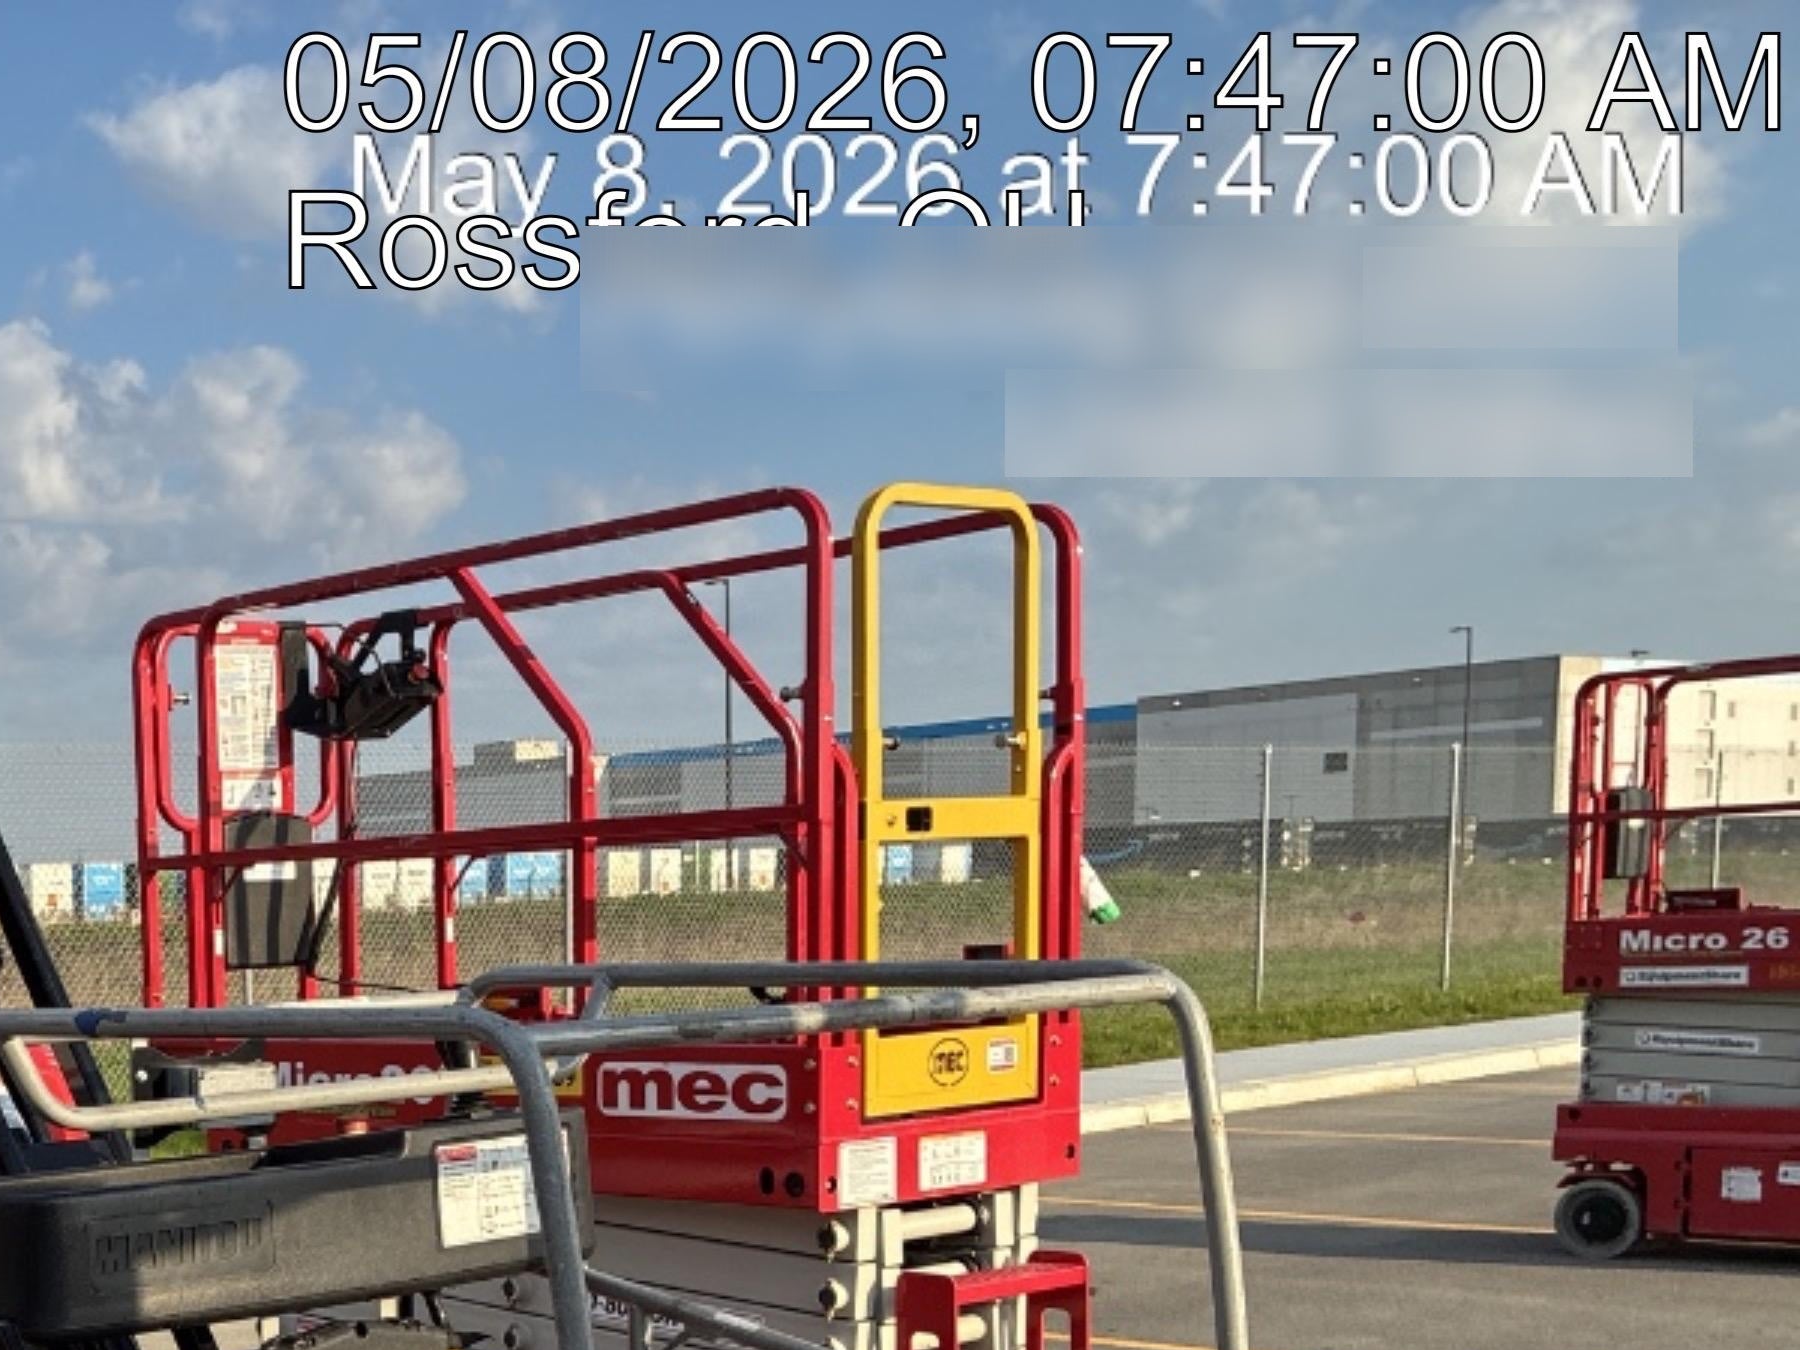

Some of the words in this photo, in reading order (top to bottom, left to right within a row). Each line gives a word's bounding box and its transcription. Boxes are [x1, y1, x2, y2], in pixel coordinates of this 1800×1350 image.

[1619, 928, 1729, 952] Micro
[1740, 925, 1790, 950] 26
[601, 1068, 785, 1115] mec
